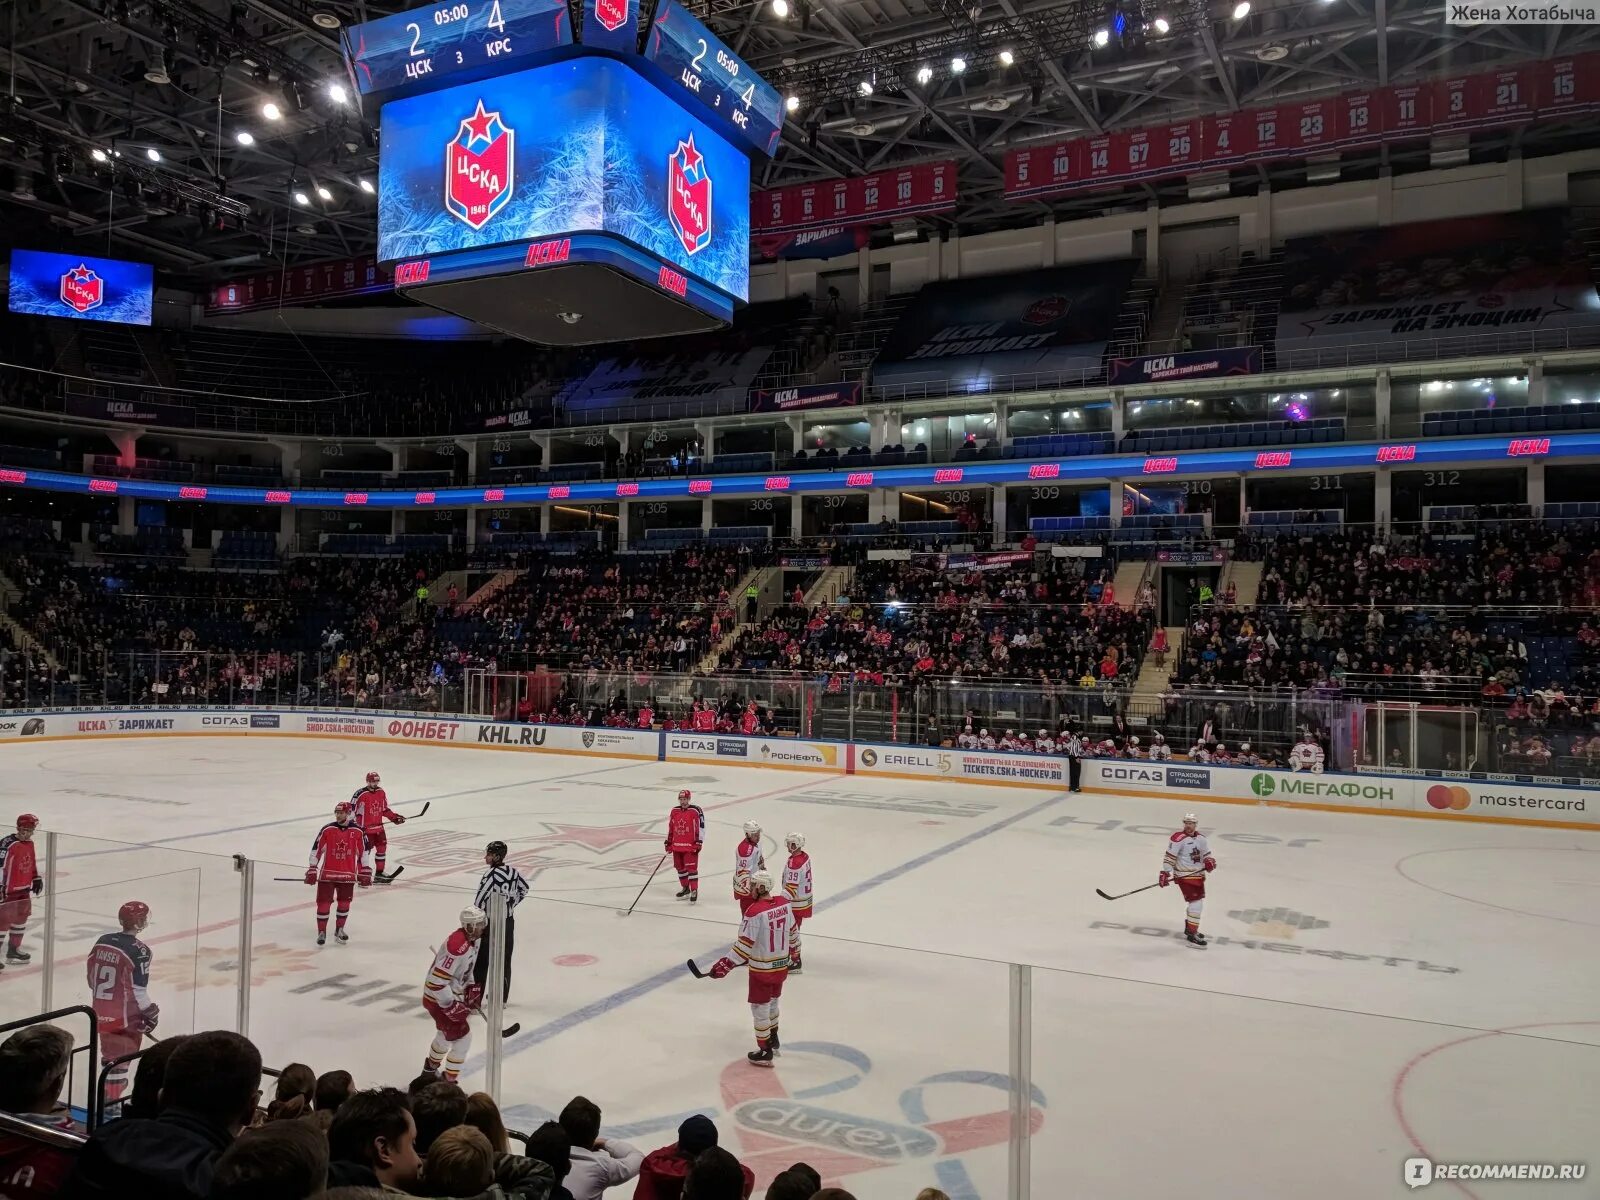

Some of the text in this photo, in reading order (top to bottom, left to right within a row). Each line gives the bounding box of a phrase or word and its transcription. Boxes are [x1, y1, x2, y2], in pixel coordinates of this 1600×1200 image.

[434, 4, 468, 25] 05:00
[487, 0, 506, 33] 4
[406, 22, 424, 56] 2
[486, 38, 512, 57] КРС
[455, 51, 463, 64] 3
[692, 38, 707, 72] 2
[717, 50, 738, 76] 05:00
[406, 58, 433, 78] ЦСК
[682, 68, 702, 92] ЦСК
[1553, 75, 1574, 96] 15
[714, 94, 720, 106] 3
[742, 83, 756, 110] 4
[1451, 92, 1463, 111] 3
[1497, 84, 1518, 105] 21
[1350, 107, 1368, 128] 13
[1399, 100, 1415, 119] 11
[732, 108, 749, 129] КРС
[1301, 116, 1323, 136] 23
[1218, 130, 1228, 148] 4
[1257, 122, 1276, 140] 12
[1129, 143, 1149, 163] 67
[1170, 136, 1190, 156] 26
[1053, 156, 1069, 175] 10
[1091, 150, 1108, 168] 14
[458, 154, 500, 194] ЦСКА
[1018, 163, 1028, 180] 5
[898, 181, 911, 199] 18
[934, 176, 944, 193] 9
[676, 174, 703, 230] ЦСКА
[835, 193, 846, 209] 11
[864, 188, 878, 205] 12
[470, 205, 486, 215] 1946
[772, 203, 780, 219] 3
[524, 239, 571, 267] ЦСКА
[658, 265, 687, 297] ЦСКА
[68, 282, 94, 301] ЦСКА
[1325, 301, 1466, 324] ЗАРЯЖАЕТ
[1392, 308, 1542, 333] НА ЭМОЦИИ
[1144, 357, 1174, 373] ЦСКА
[774, 389, 798, 404] ЦСКА
[107, 402, 133, 412] ЦСКА
[584, 436, 604, 447] 404
[647, 431, 668, 442] 405
[322, 446, 344, 456] 401
[436, 446, 455, 456] 402
[493, 441, 511, 452] 403
[1376, 445, 1416, 462] ЦСКА
[1507, 438, 1550, 457] ЦСКА
[1143, 457, 1178, 473] ЦСКА
[1254, 451, 1292, 469] ЦСКА
[846, 473, 874, 487] ЦСКА
[934, 468, 964, 483] ЦСКА
[1028, 464, 1060, 479] ЦСКА
[1424, 471, 1460, 487] 312
[616, 483, 639, 496] ЦСКА
[689, 480, 712, 492] ЦСКА
[765, 476, 791, 491] ЦСКА
[1180, 481, 1212, 494] 310
[1310, 475, 1344, 490] 311
[823, 496, 847, 508] 307
[944, 491, 970, 504] 308
[1032, 487, 1060, 500] 309
[647, 503, 668, 514] 305
[750, 499, 772, 511] 306
[79, 719, 174, 731] ЦСКА ЗАРЯЖАЕТ
[202, 717, 248, 725] СОГАЗ
[306, 724, 375, 734] SHOP.CSKA-HOCKEY.RU
[388, 720, 459, 740] ФОНБЕТ
[478, 725, 546, 745] KHL.RU
[672, 740, 715, 750] СОГАЗ
[772, 752, 823, 762] РОСНЕФТЬ
[884, 754, 934, 767] ERIELL
[963, 764, 1062, 779] TICKETS.CSKA-HOCKEY.RU
[1101, 767, 1163, 782] СОГАЗ
[1169, 771, 1207, 779] СТРАХОВАЯ
[1479, 792, 1585, 811] mastercard
[1048, 816, 1322, 848] Haer
[788, 872, 798, 881] 39
[769, 918, 786, 952] 17
[442, 955, 454, 970] 18
[93, 963, 117, 1000] 12
[750, 1102, 935, 1160] durex
